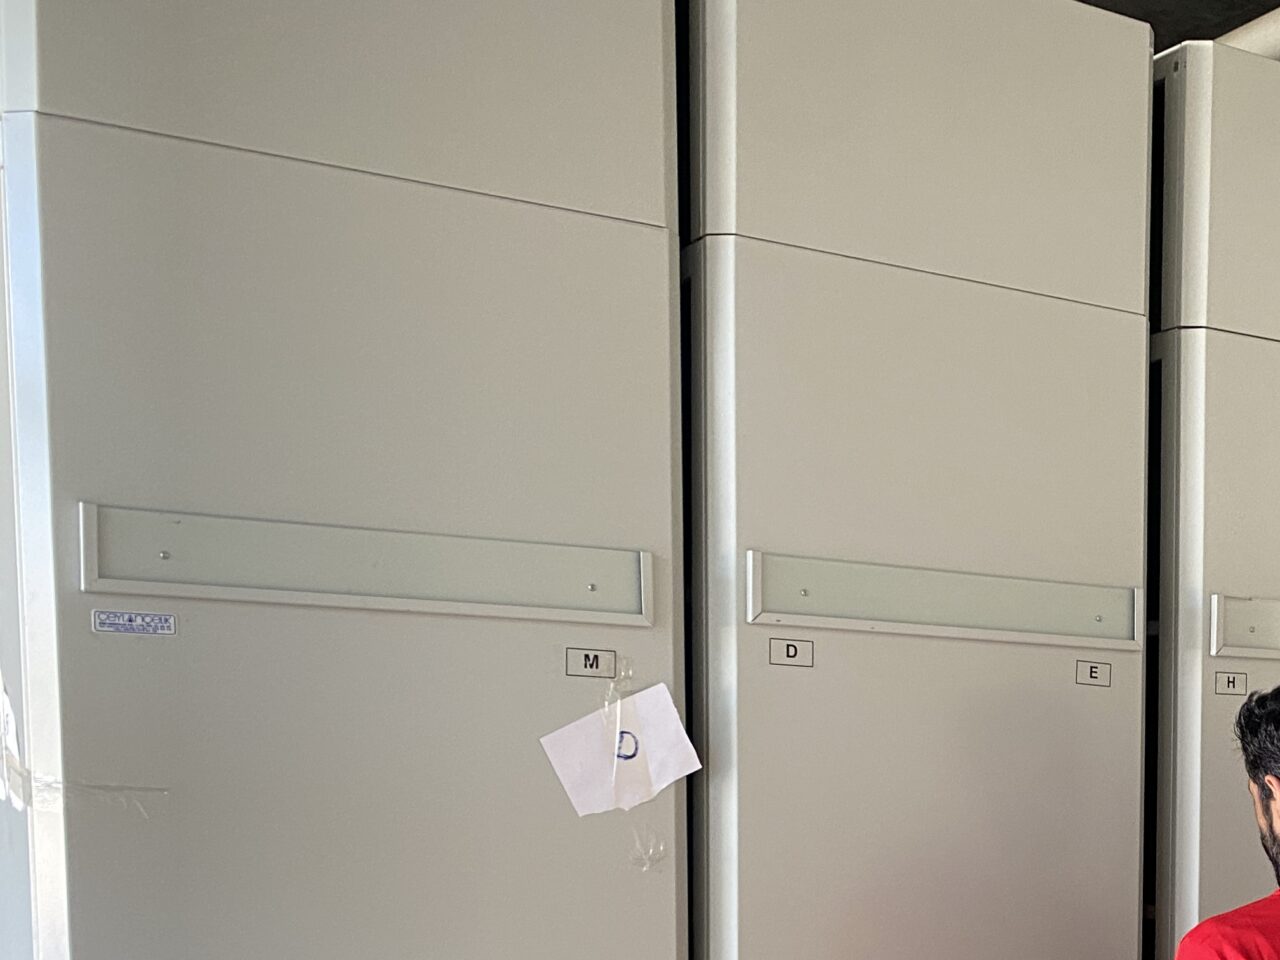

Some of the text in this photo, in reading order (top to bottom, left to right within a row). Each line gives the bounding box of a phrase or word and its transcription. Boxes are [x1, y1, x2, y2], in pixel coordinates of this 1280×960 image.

[786, 643, 798, 658] D
[583, 653, 600, 670] M
[1089, 665, 1099, 680] E
[1227, 675, 1236, 689] H
[616, 730, 639, 760] D
